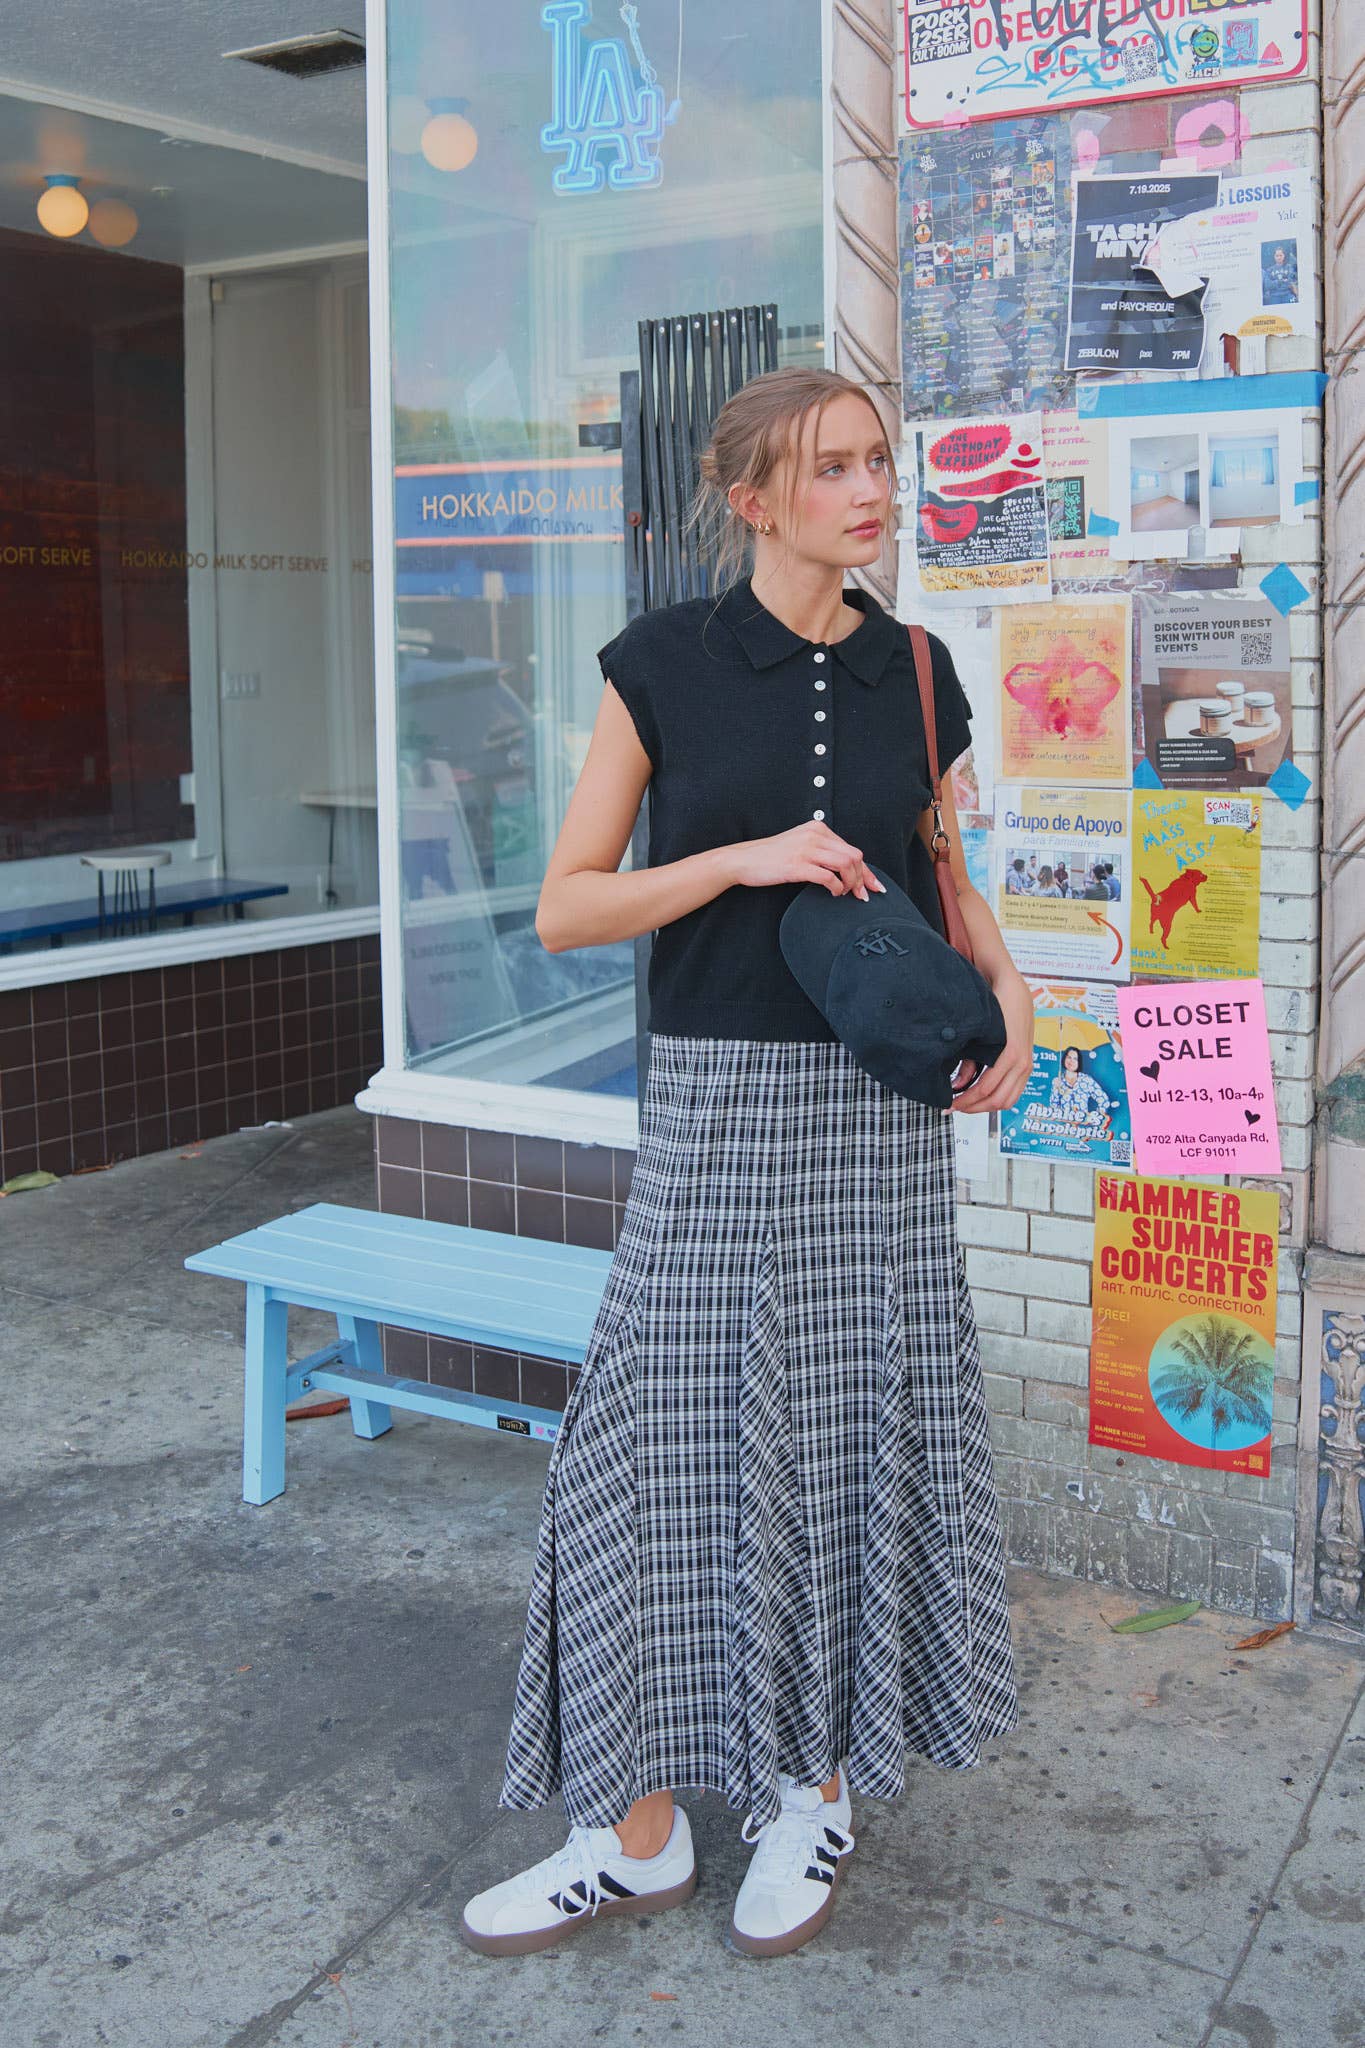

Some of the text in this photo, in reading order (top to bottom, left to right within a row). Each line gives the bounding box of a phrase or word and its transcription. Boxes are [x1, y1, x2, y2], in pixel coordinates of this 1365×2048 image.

[911, 6, 968, 33] PORK
[542, 0, 664, 195] LA
[970, 149, 992, 161] JULY
[1229, 183, 1291, 205] Lessons
[1278, 209, 1299, 221] Yale
[1101, 301, 1174, 313] and PAYCHEQUE
[1077, 348, 1191, 360] ZEBULON 7PM
[940, 437, 1003, 454] BIRTHDAY
[949, 433, 968, 442] THE
[936, 450, 1001, 468] EXPERIENCE
[422, 484, 624, 521] HOKKAIDO MILK
[1003, 497, 1036, 507] SPECIAL
[0, 548, 329, 573] OFT SERVE HOKKAIDO MILK SOFT SERVE
[1154, 618, 1272, 632] DISCOVER YOUR BEST
[1154, 631, 1235, 643] SKIN WITH OUR
[1154, 643, 1198, 653] EVENTS
[1206, 801, 1231, 813] SCAN
[1005, 811, 1123, 838] Grupo de Apoyo
[1212, 815, 1229, 825] BUTT
[1143, 823, 1185, 853] MASS
[1175, 834, 1216, 872] ASS!
[1134, 1002, 1250, 1028] CLOSET
[1158, 1037, 1233, 1061] SALE
[1139, 1086, 1264, 1104] Jul 12-13, 10a-4p
[1024, 1102, 1104, 1126] Awake &
[1022, 1118, 1106, 1139] Narcoleptic
[1040, 1138, 1062, 1147] WITH
[1146, 1132, 1269, 1146] 4702 Alta Canyada Rd,
[1180, 1148, 1237, 1158] LCF 91011
[1099, 1177, 1241, 1228] HAMMER
[1131, 1217, 1274, 1268] SUMMER
[1100, 1247, 1268, 1301] CONCERTS
[1101, 1281, 1266, 1316] ART. MUSIC. CONNECTION.
[1097, 1307, 1130, 1322] FREE!
[1095, 1424, 1120, 1434] HAMMER
[1122, 1431, 1145, 1441] MUSEUM
